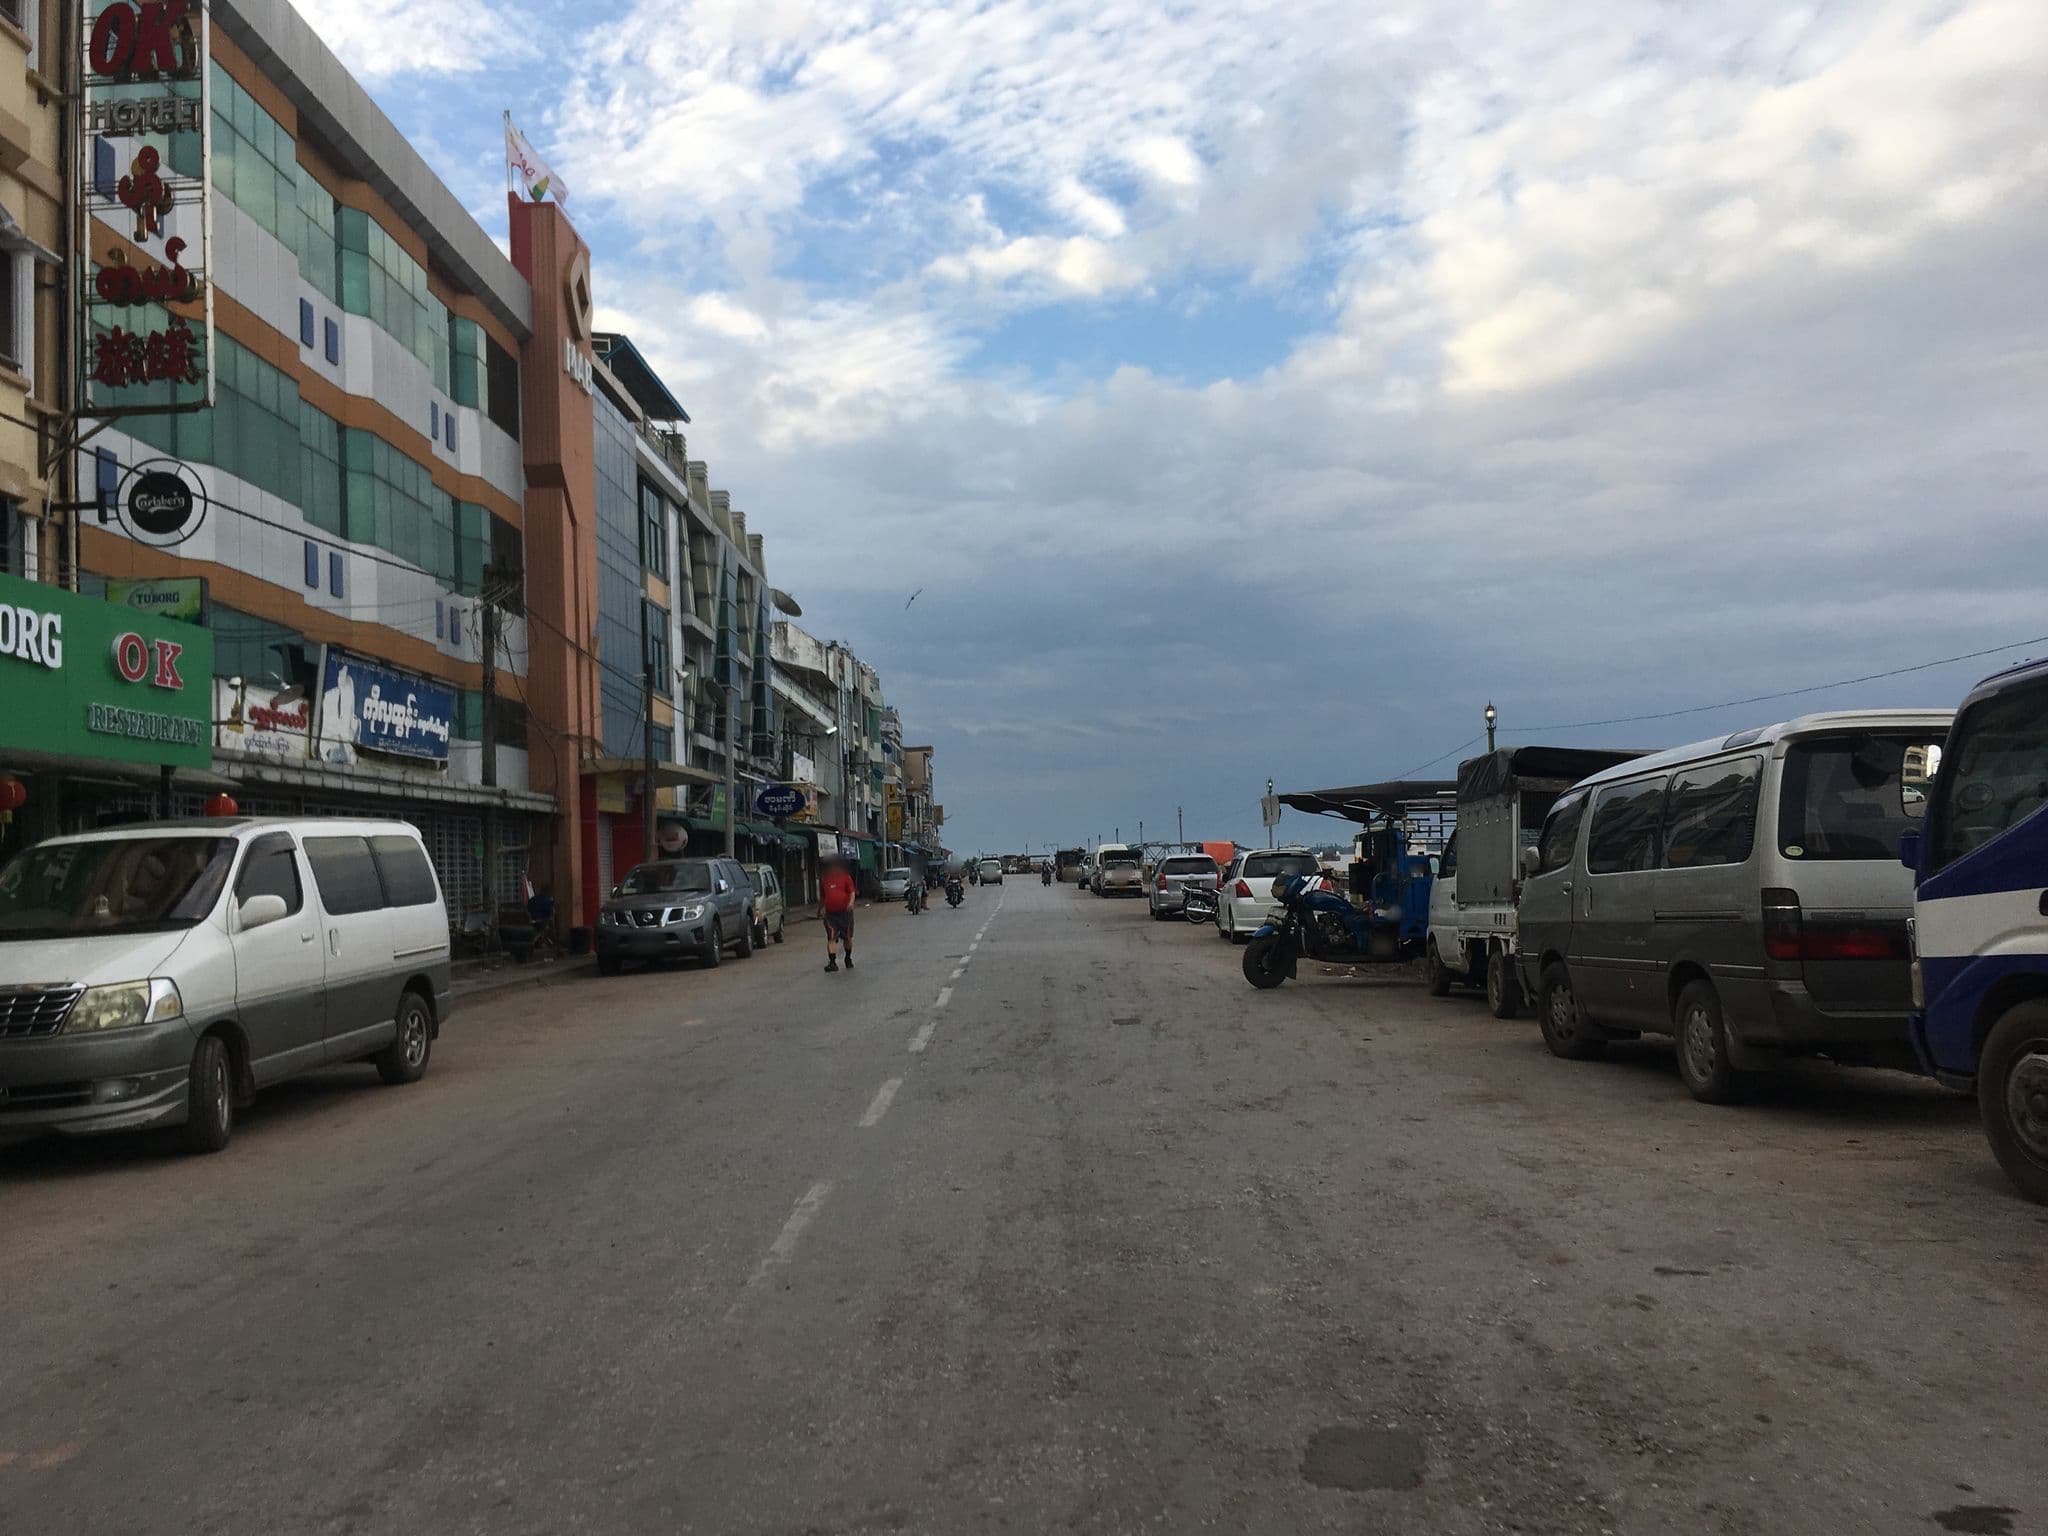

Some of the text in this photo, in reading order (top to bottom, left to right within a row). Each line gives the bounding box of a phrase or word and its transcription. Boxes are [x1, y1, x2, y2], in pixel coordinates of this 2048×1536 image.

[89, 0, 188, 78] OK
[90, 97, 197, 131] HOTEL
[135, 493, 185, 513] Carlsberg
[136, 591, 180, 605] TUBORG
[88, 702, 203, 747] RESTAURANT
